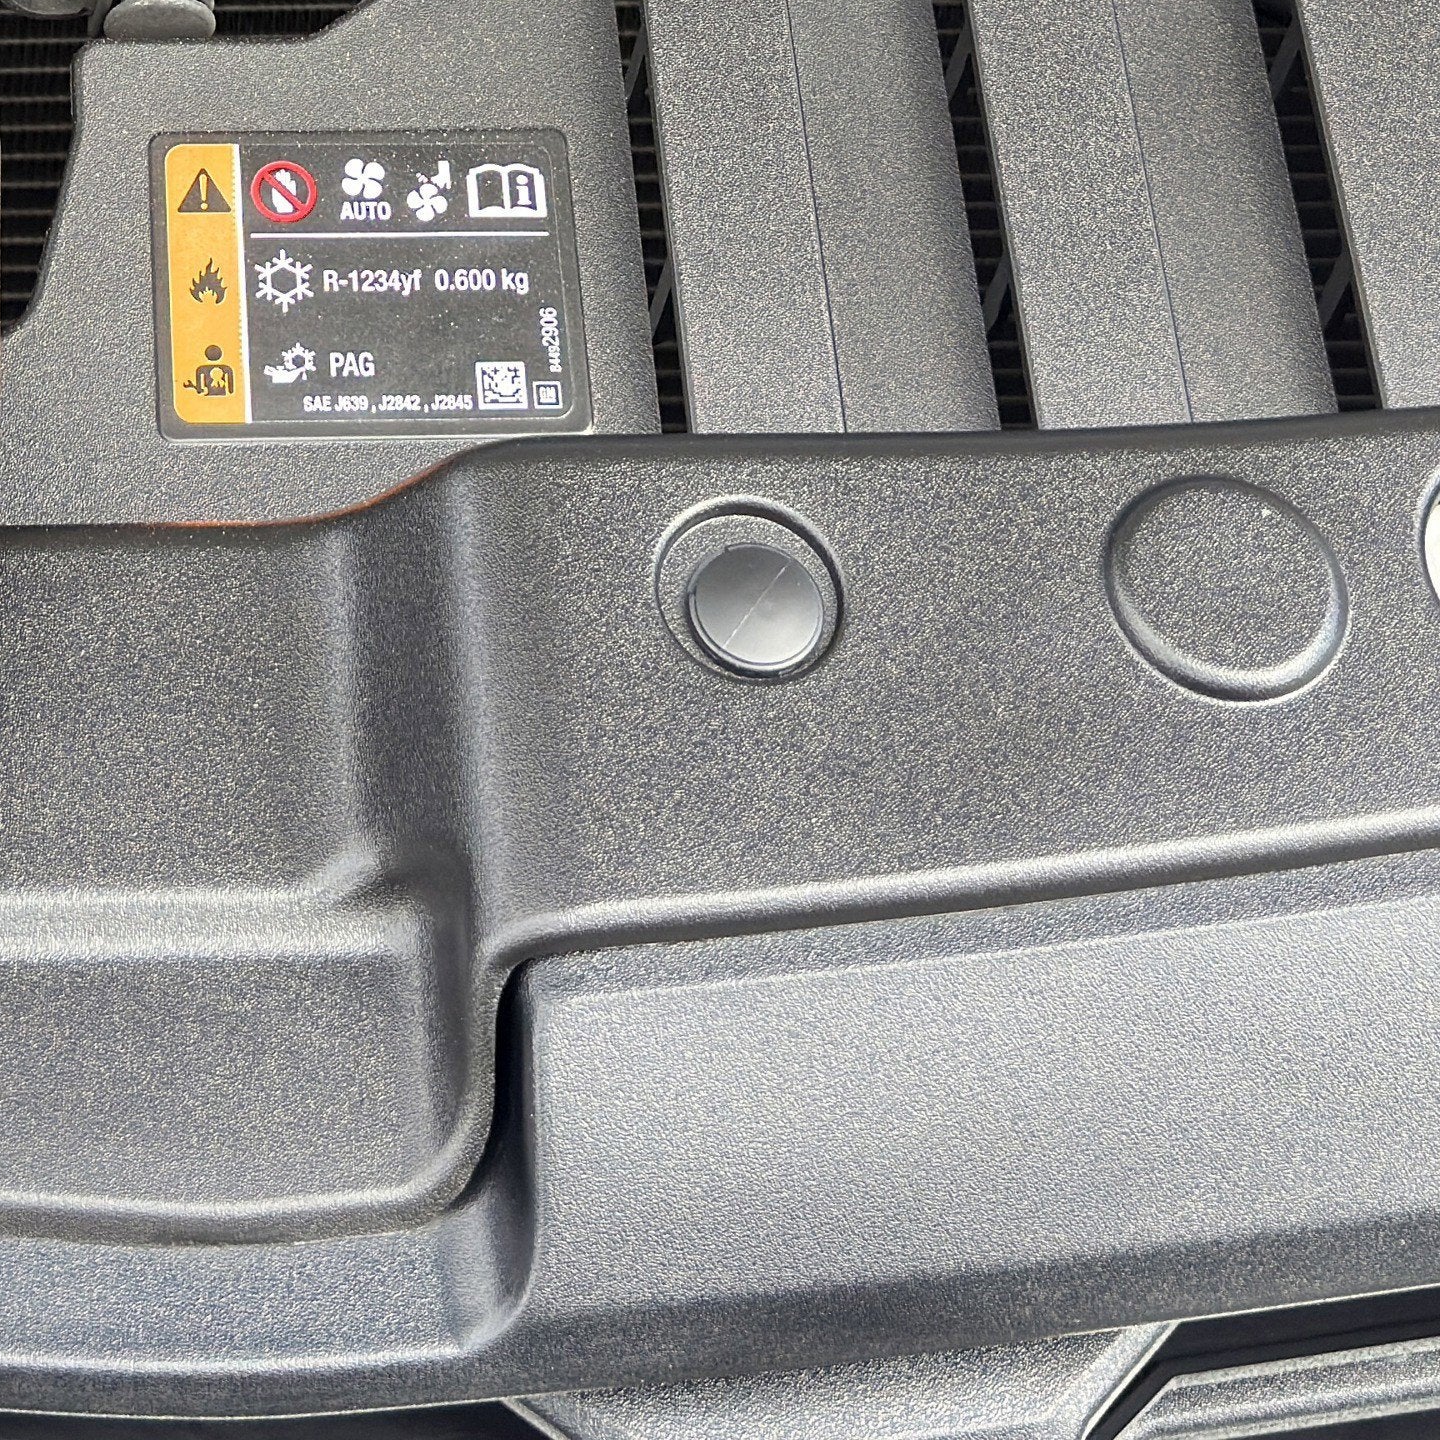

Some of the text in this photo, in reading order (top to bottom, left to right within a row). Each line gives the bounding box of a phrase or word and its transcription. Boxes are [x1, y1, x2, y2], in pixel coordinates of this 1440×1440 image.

[339, 201, 392, 221] AUTO
[322, 268, 530, 297] R-1234yf 0.600 kg
[329, 351, 376, 378] PAG
[302, 395, 333, 413] SAE
[430, 394, 474, 412] J2845
